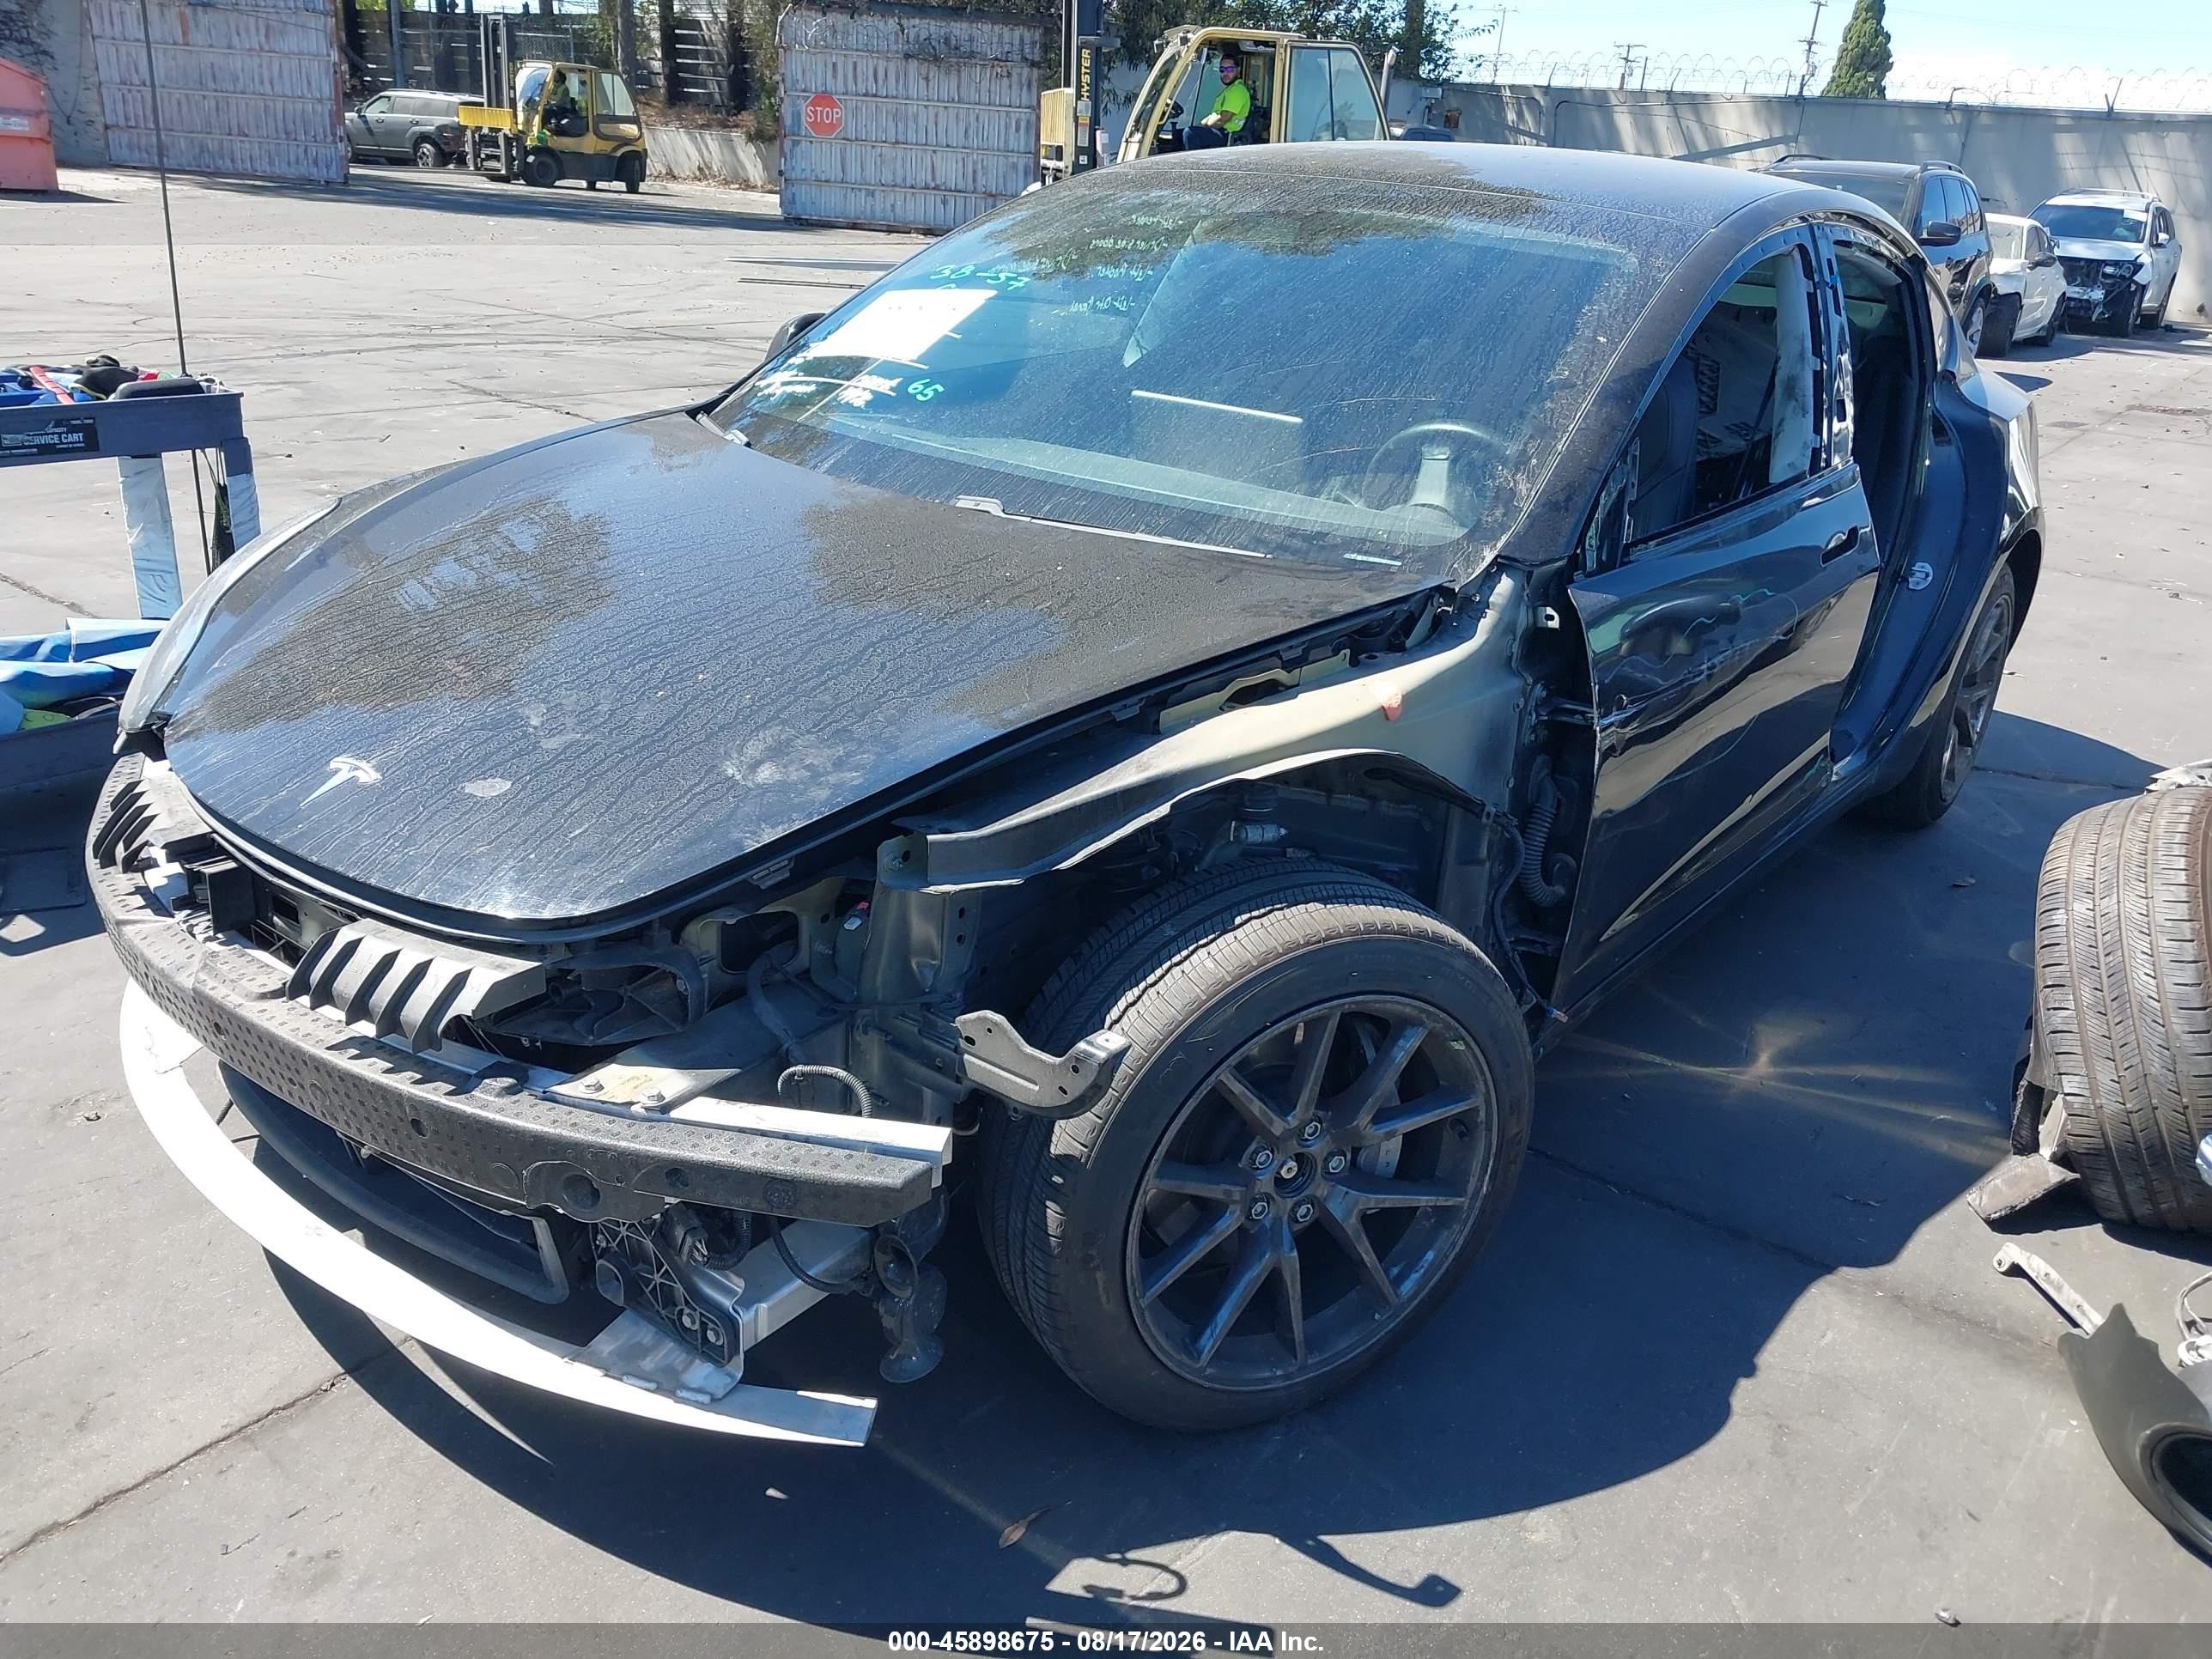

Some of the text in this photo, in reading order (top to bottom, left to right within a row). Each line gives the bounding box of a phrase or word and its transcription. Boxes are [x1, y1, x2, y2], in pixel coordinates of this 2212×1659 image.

[1080, 48, 1091, 100] HYSTER
[806, 106, 842, 124] STOP
[907, 378, 945, 402] 65
[23, 434, 60, 446] ERVICE
[61, 433, 84, 442] CART
